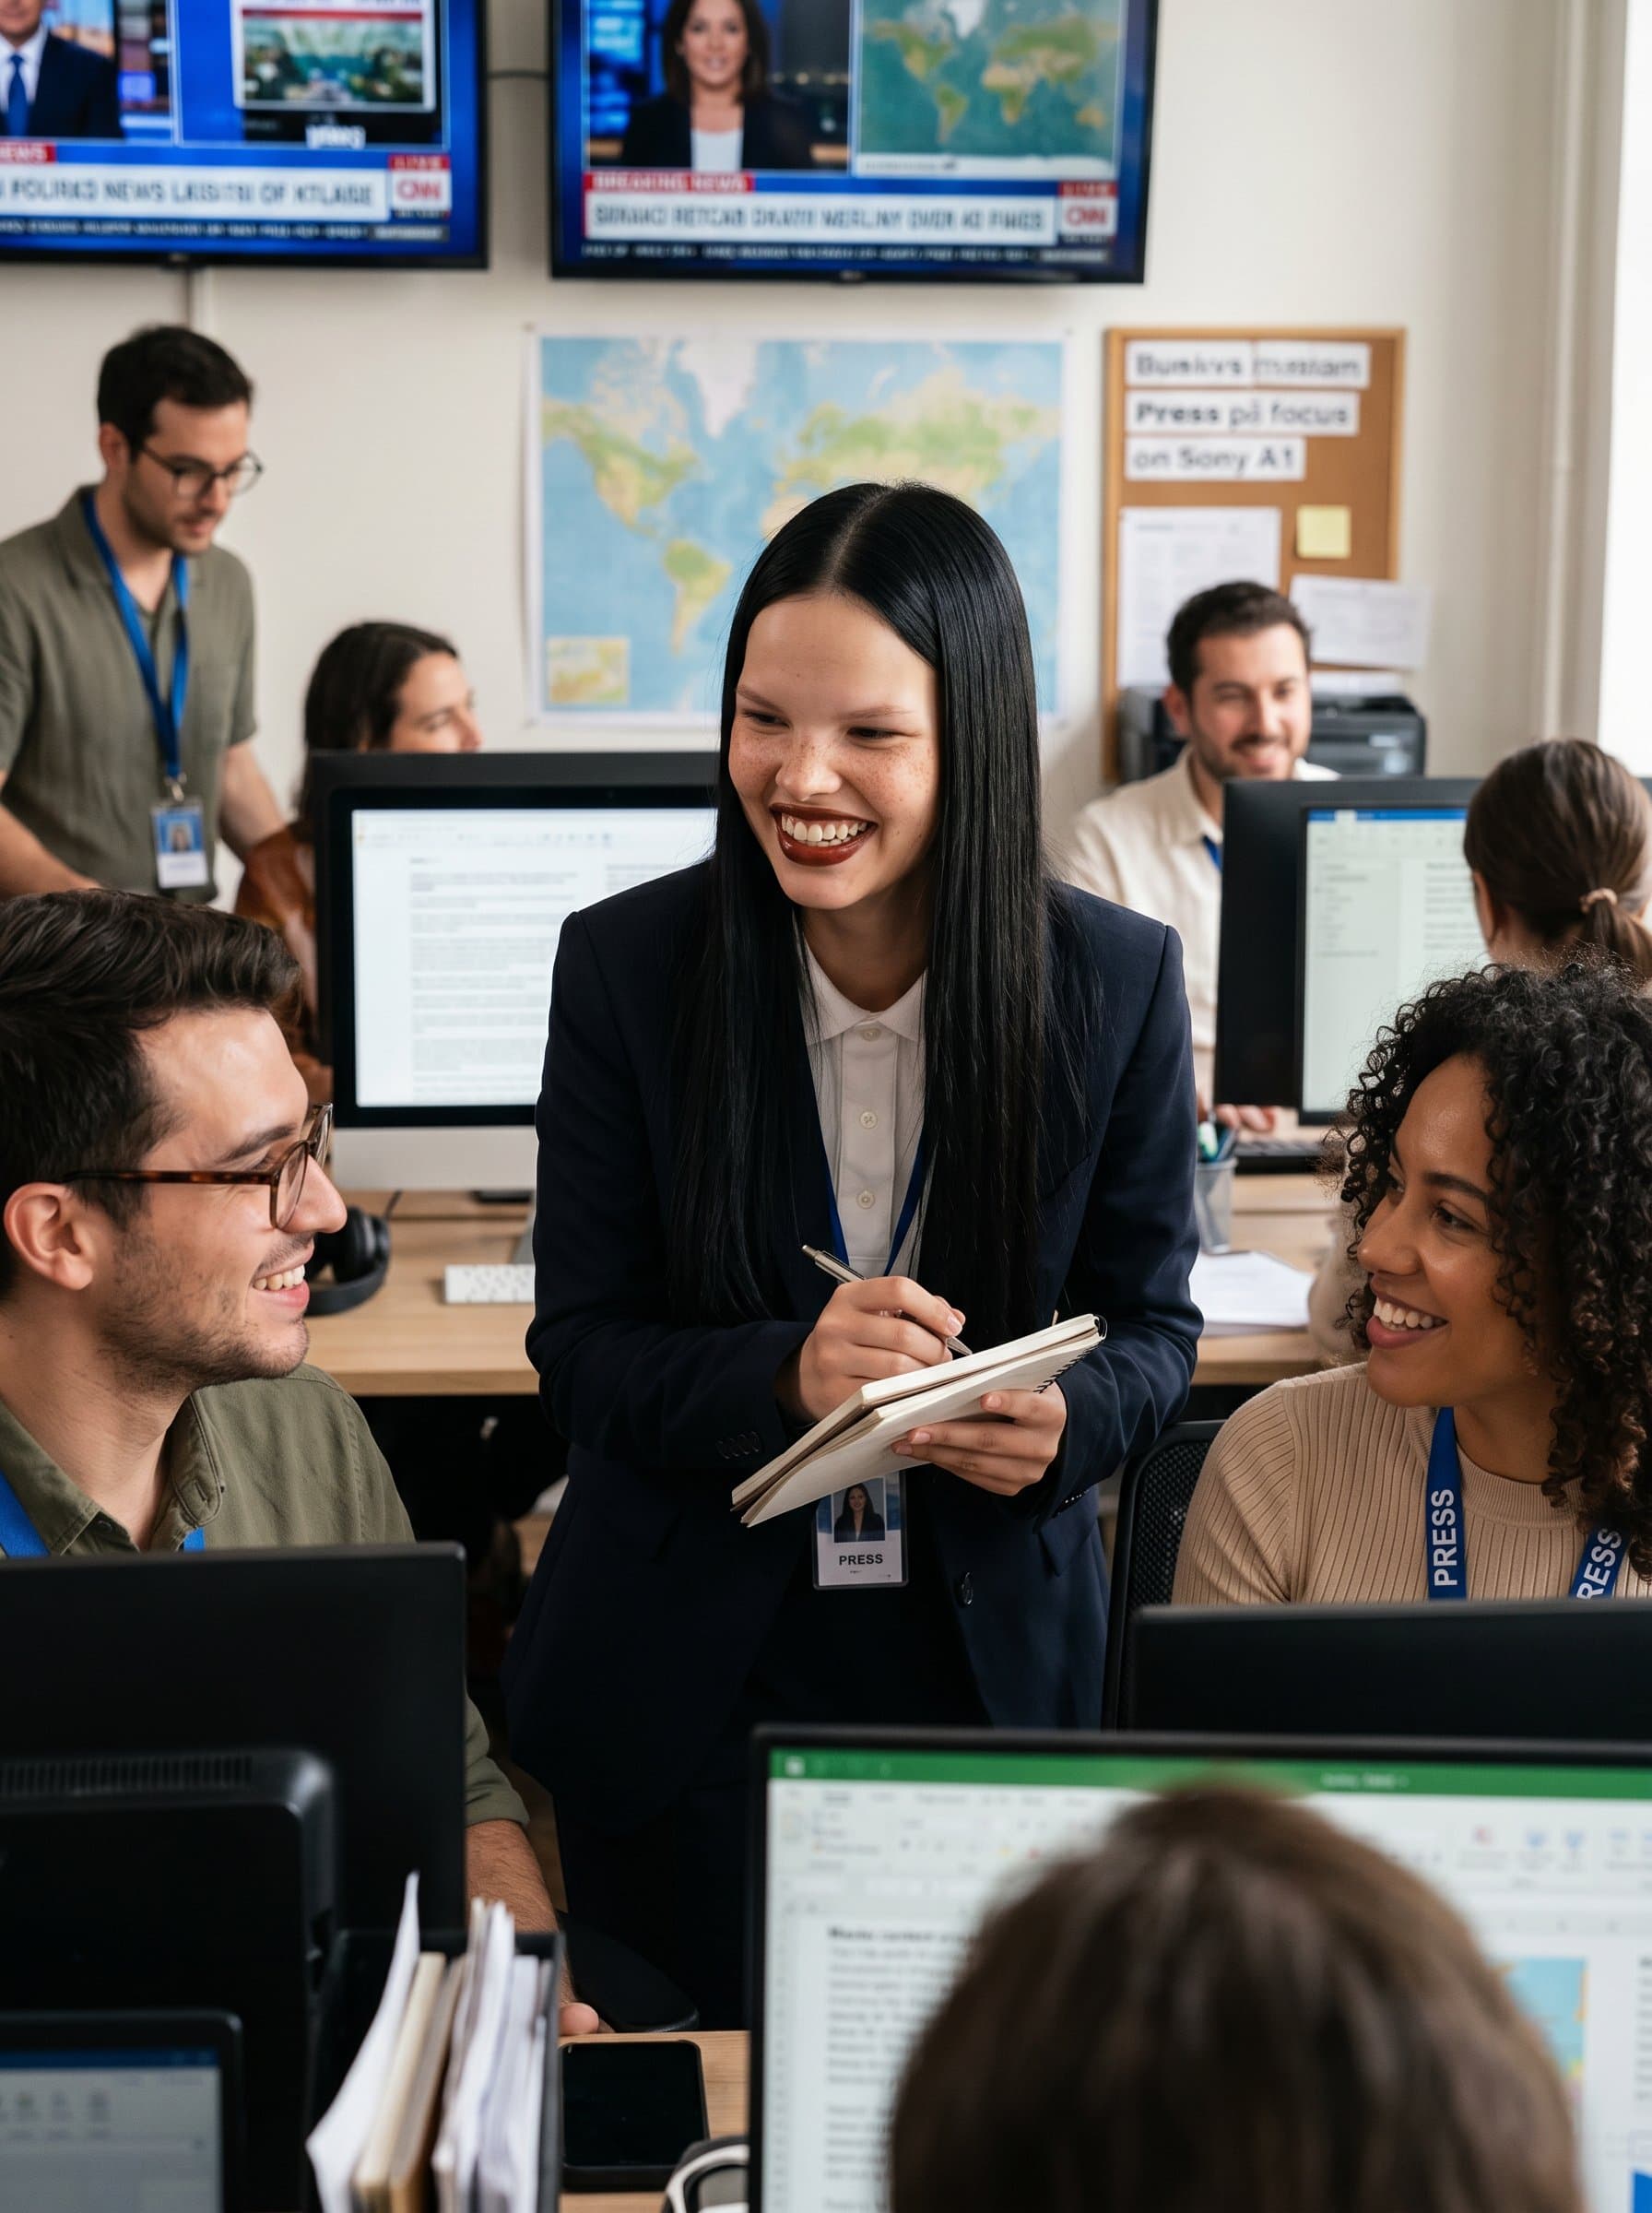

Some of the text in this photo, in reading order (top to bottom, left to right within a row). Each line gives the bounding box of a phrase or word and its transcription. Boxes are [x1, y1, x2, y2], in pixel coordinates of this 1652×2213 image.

[0, 144, 48, 164] EWS
[1135, 402, 1221, 423] Press
[1269, 401, 1349, 425] focus
[1134, 451, 1171, 469] on
[1178, 445, 1249, 478] Sony
[1431, 1489, 1459, 1587] PRESS
[838, 1553, 884, 1567] PRESS
[1575, 1527, 1623, 1601] RESS
